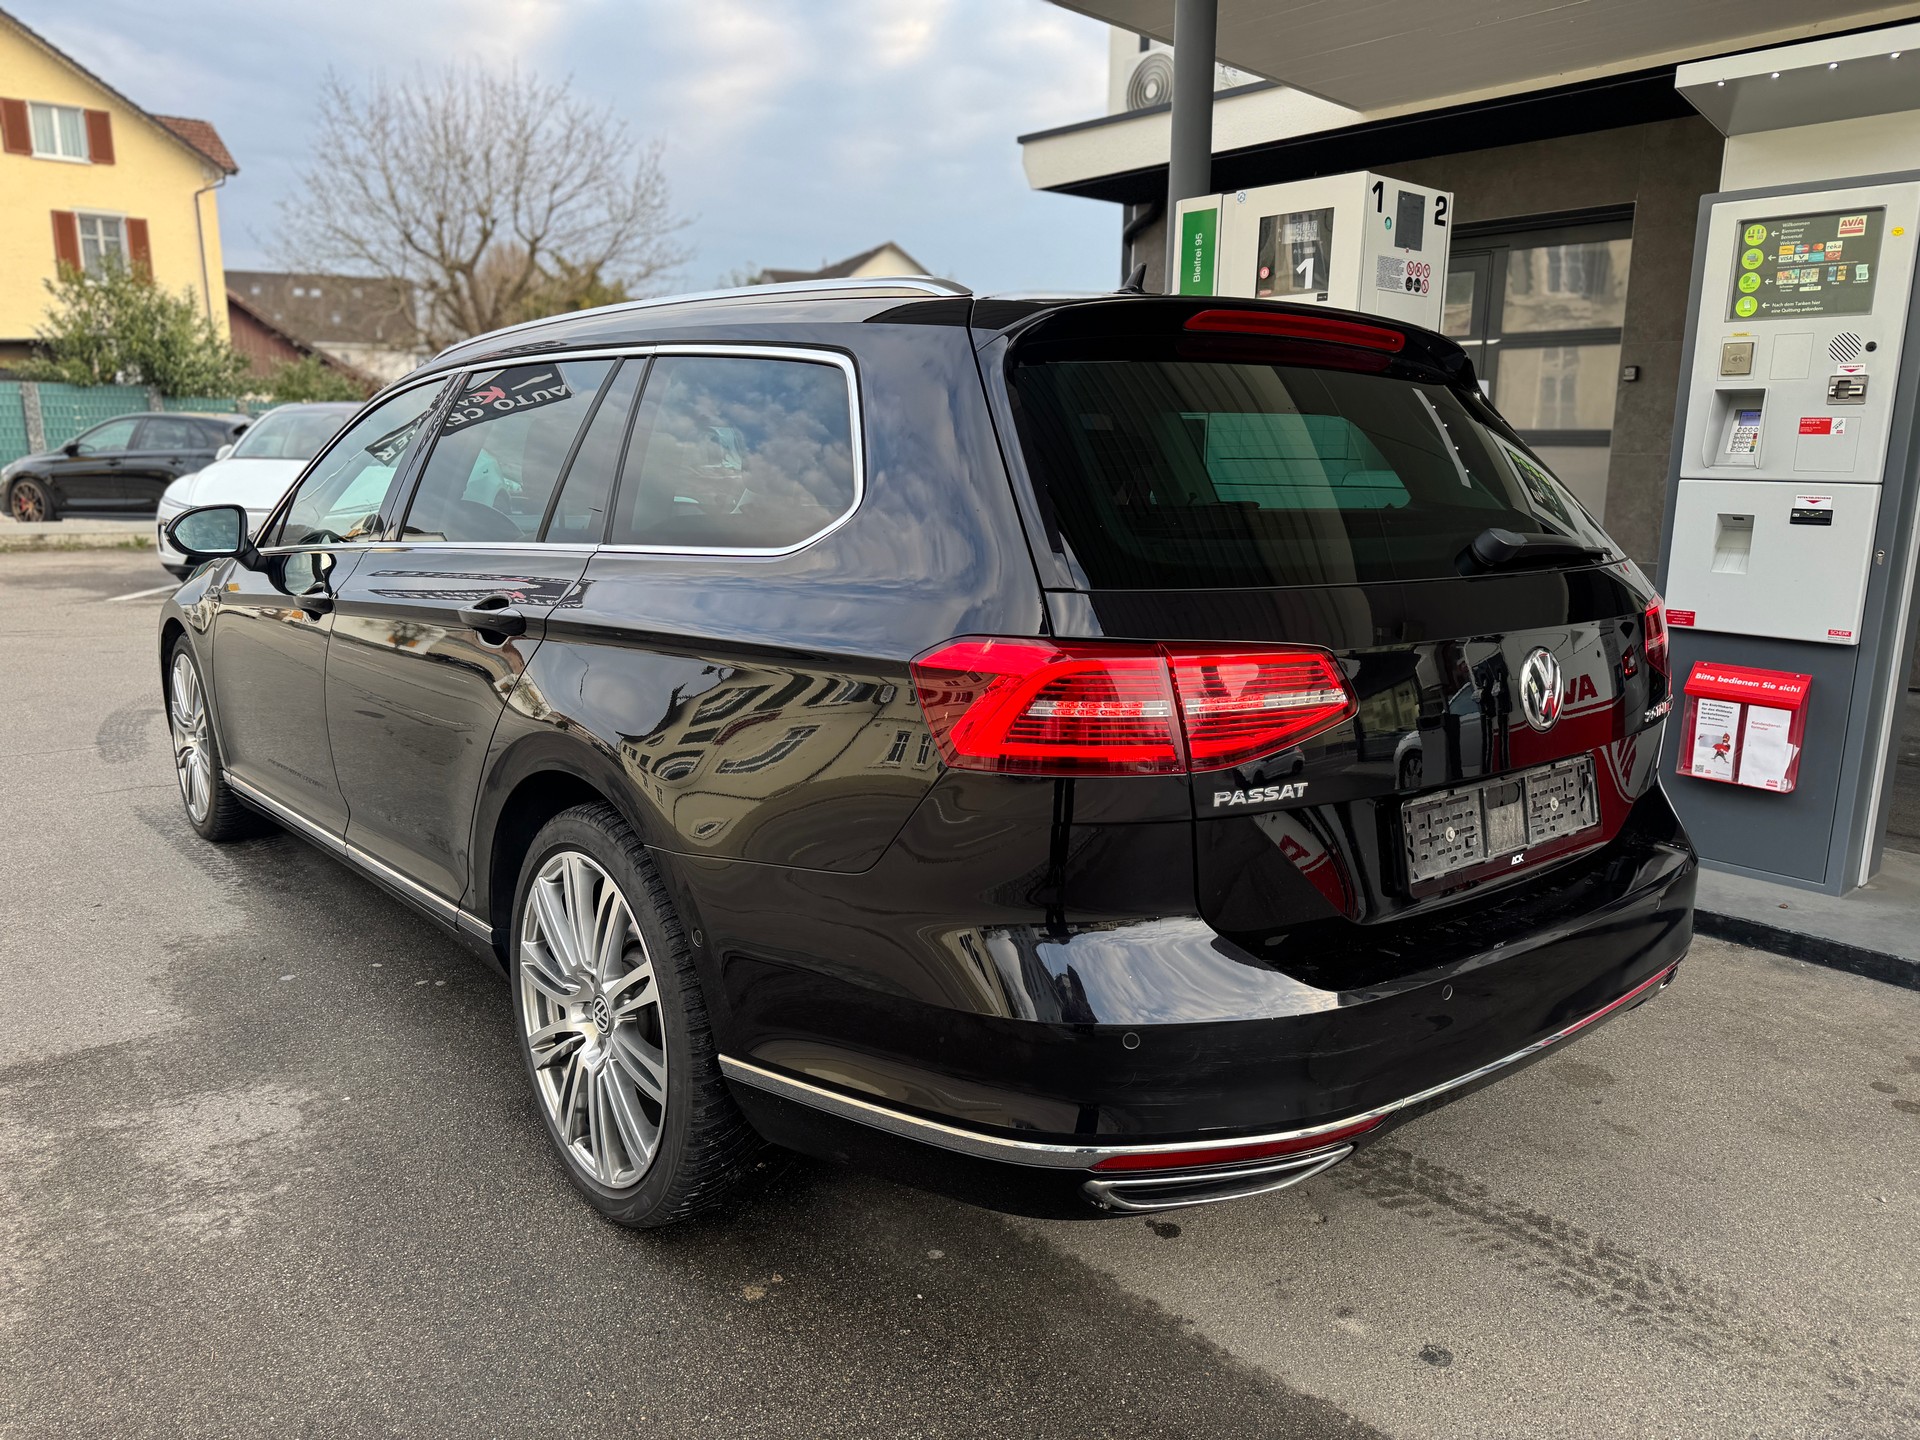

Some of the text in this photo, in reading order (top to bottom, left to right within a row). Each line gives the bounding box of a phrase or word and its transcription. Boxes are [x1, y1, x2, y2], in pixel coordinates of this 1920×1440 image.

[1371, 180, 1384, 213] 1
[1434, 195, 1448, 227] 2
[1840, 217, 1865, 227] AVIA
[1193, 232, 1203, 283] Bleifrei 95
[1826, 243, 1842, 251] reka
[1296, 257, 1314, 290] 1
[1695, 672, 1801, 693] Bitte bedienen Sie sich!
[1213, 782, 1308, 807] PASSAT
